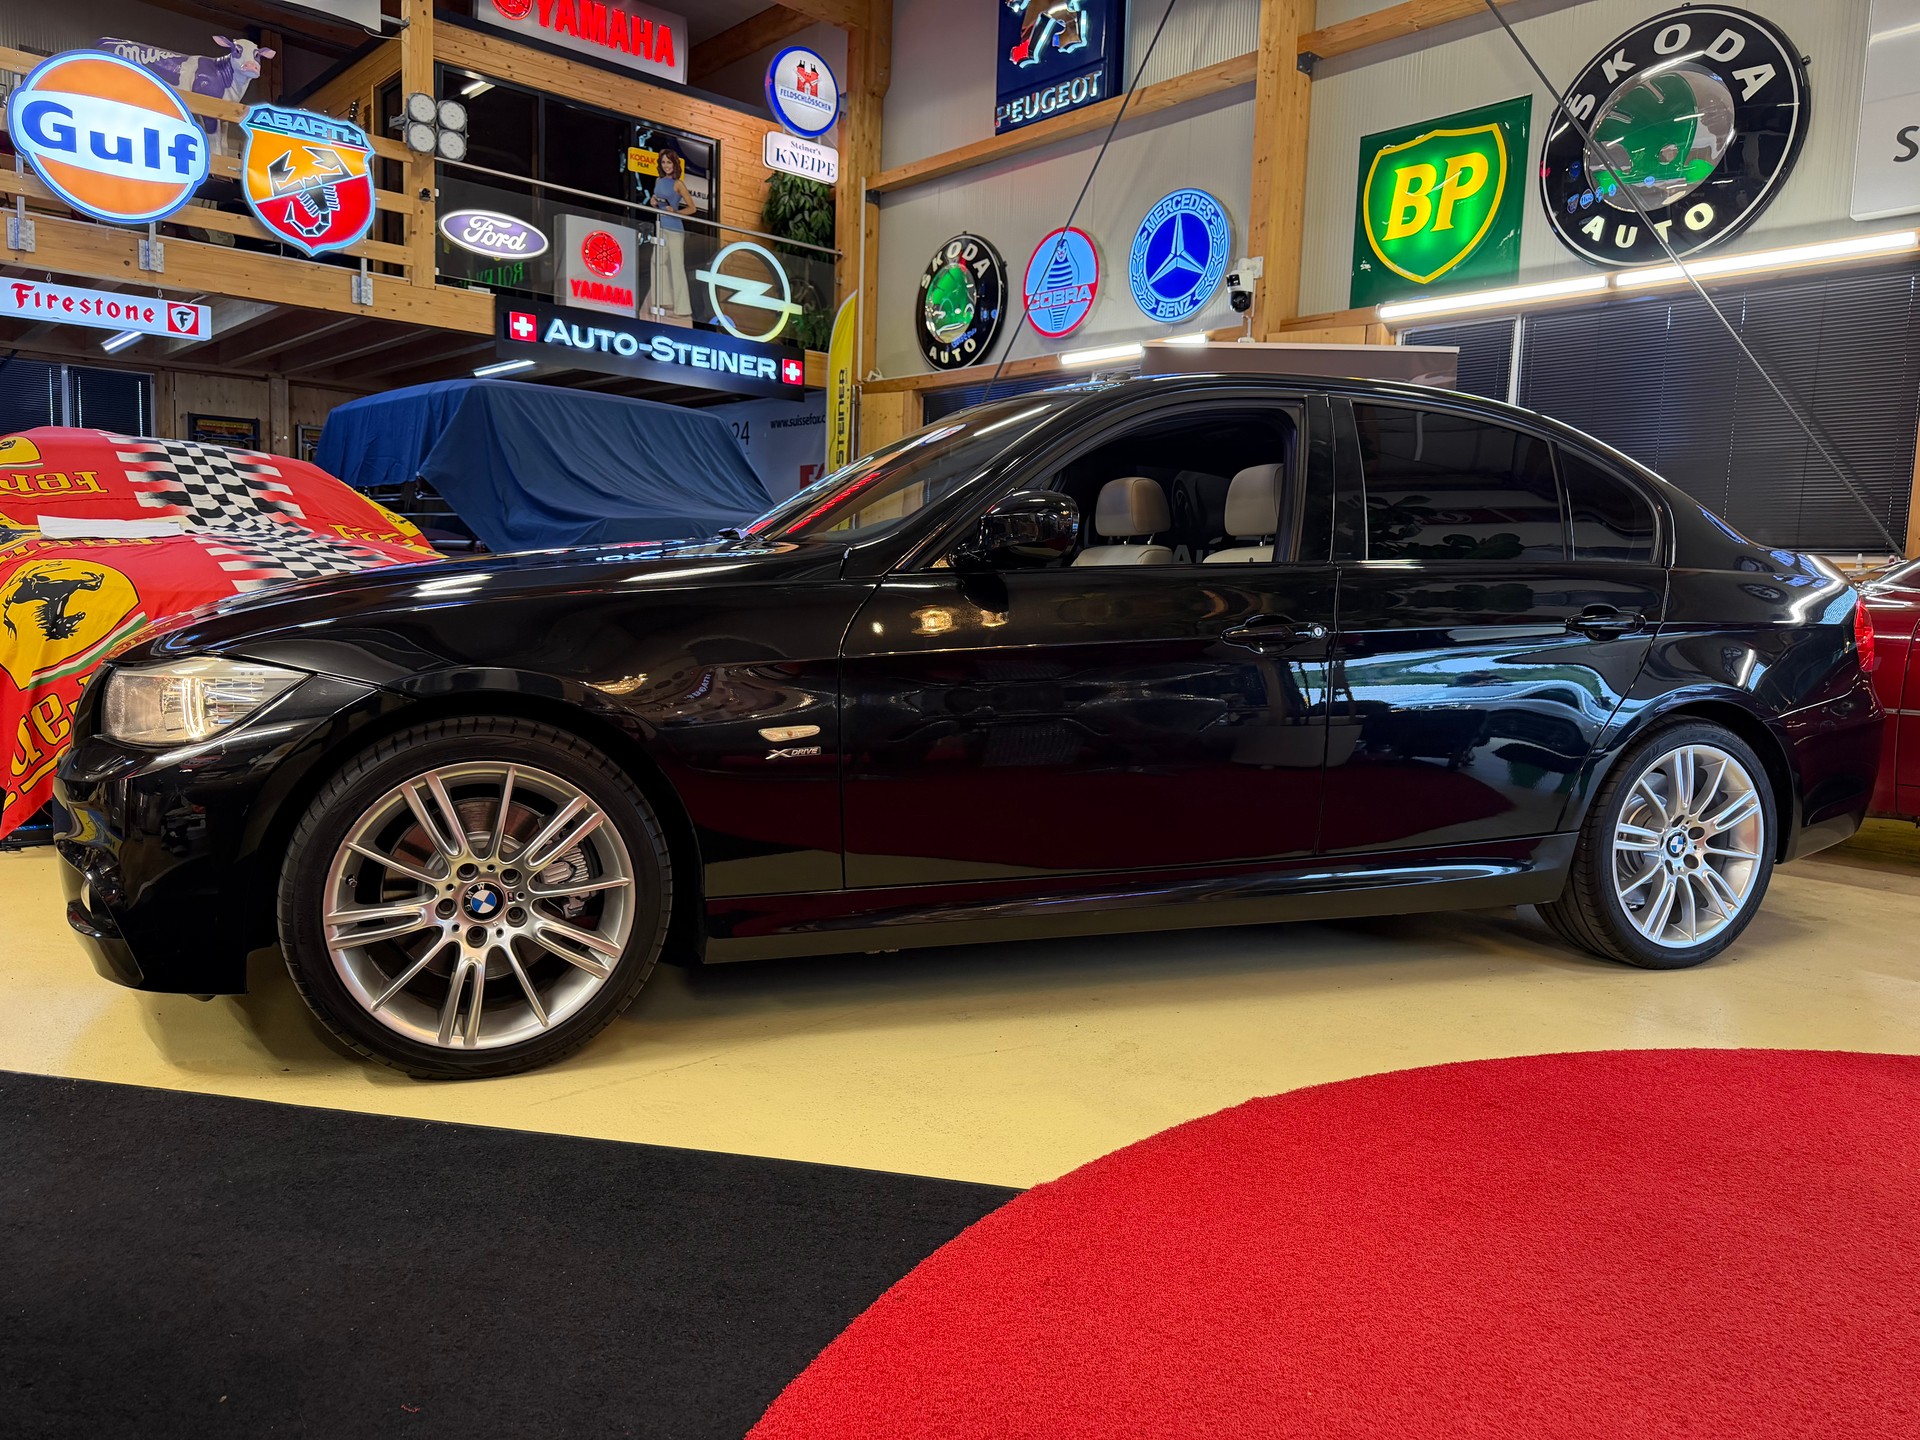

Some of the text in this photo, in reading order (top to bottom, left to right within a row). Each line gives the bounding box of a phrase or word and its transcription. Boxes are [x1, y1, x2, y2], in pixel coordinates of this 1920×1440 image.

[538, 0, 675, 67] YAMAHA
[780, 88, 831, 112] FELDSCHLÖSSCHEN
[995, 70, 1103, 128] PEUGEOT
[21, 100, 198, 175] Gulf
[253, 112, 363, 145] ABARTH
[630, 153, 656, 165] KODAK
[775, 147, 836, 178] KNEIPE
[1144, 194, 1214, 233] MERCEDES
[1382, 152, 1489, 241] BP
[463, 215, 526, 251] Ford
[1582, 203, 1714, 248] AUTO
[10, 283, 155, 323] Firestone
[570, 279, 634, 307] YAMAHA
[1028, 285, 1092, 310] COBRA
[1156, 295, 1194, 317] BENZ
[544, 318, 777, 381] AUTO-STEINER
[929, 338, 977, 363] AUTO
